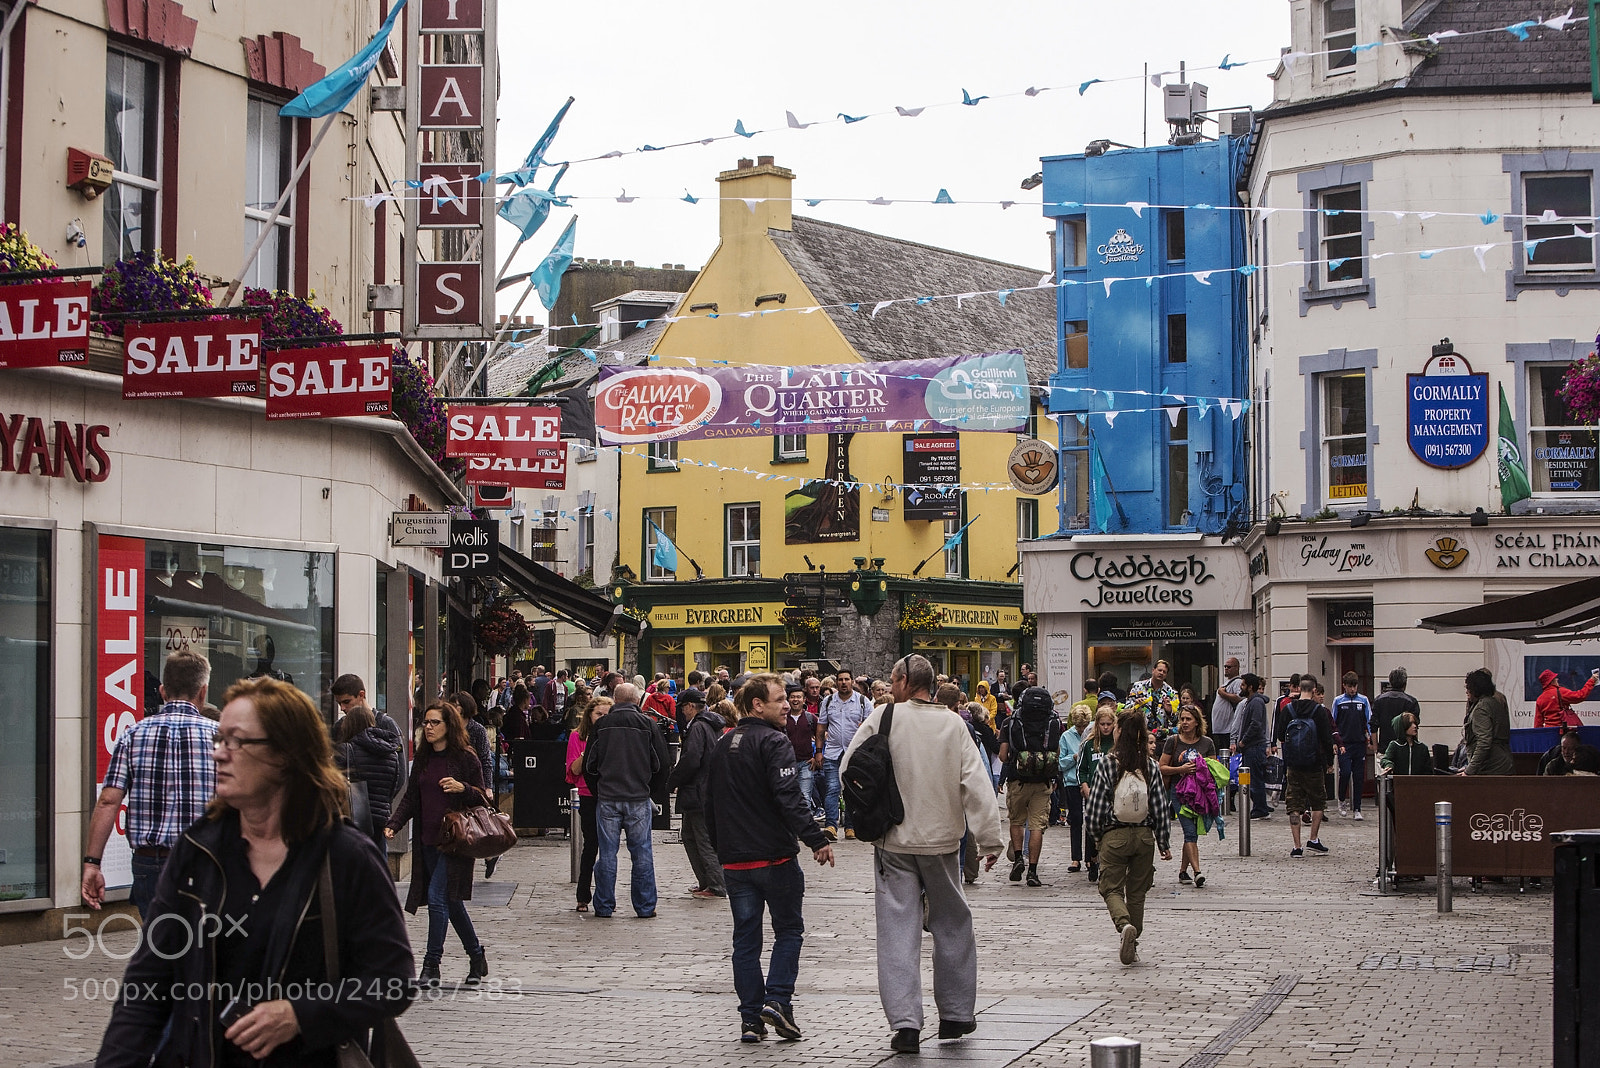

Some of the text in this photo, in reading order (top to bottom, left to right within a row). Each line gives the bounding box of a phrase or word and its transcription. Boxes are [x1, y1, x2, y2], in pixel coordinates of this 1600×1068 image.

[1097, 244, 1144, 257] Claddagh
[59, 353, 85, 362] RYANS
[127, 333, 259, 375] SALE
[269, 357, 390, 398] SALE
[743, 367, 886, 389] THE LATIN
[970, 368, 1017, 379] Gaillimh
[232, 384, 256, 393] RYANS
[604, 383, 697, 410] THE GALWAY
[1413, 385, 1481, 401] GORMALLY
[366, 404, 388, 412] RYANS
[743, 384, 889, 417] QUARTER
[938, 404, 1025, 414] Winner of the European
[1424, 408, 1471, 420] PROPERTY
[620, 405, 684, 431] RACES
[449, 414, 559, 442] SALE
[704, 421, 931, 438] GALWAY'S BIGGEST STREET ARY
[1414, 424, 1483, 436] MANAGEMENT
[0, 412, 111, 483] YANS
[1425, 444, 1472, 459] (091) 567300
[1535, 446, 1597, 460] GORMALLY
[469, 451, 565, 474] SALE
[1545, 461, 1588, 469] RESIDENTIAL
[1550, 470, 1582, 478] LETTINGS
[395, 516, 448, 527] Augustinian
[405, 526, 437, 535] Church
[452, 527, 489, 546] wallis
[1301, 535, 1317, 543] FROM
[1301, 536, 1341, 567] Galway
[451, 553, 490, 569] DP
[1070, 551, 1215, 588] Claddagh
[1080, 584, 1194, 608] Jewellers
[654, 612, 679, 621] HEALTH
[685, 606, 764, 625] EVERGREEN
[941, 607, 1018, 626] EVERGREEN STORE
[165, 626, 207, 651] 20% OFF
[104, 567, 138, 758] SALE
[577, 665, 597, 679] SUBWA
[780, 767, 795, 777] HH
[1469, 808, 1544, 833] cafe
[1470, 830, 1543, 844] express
